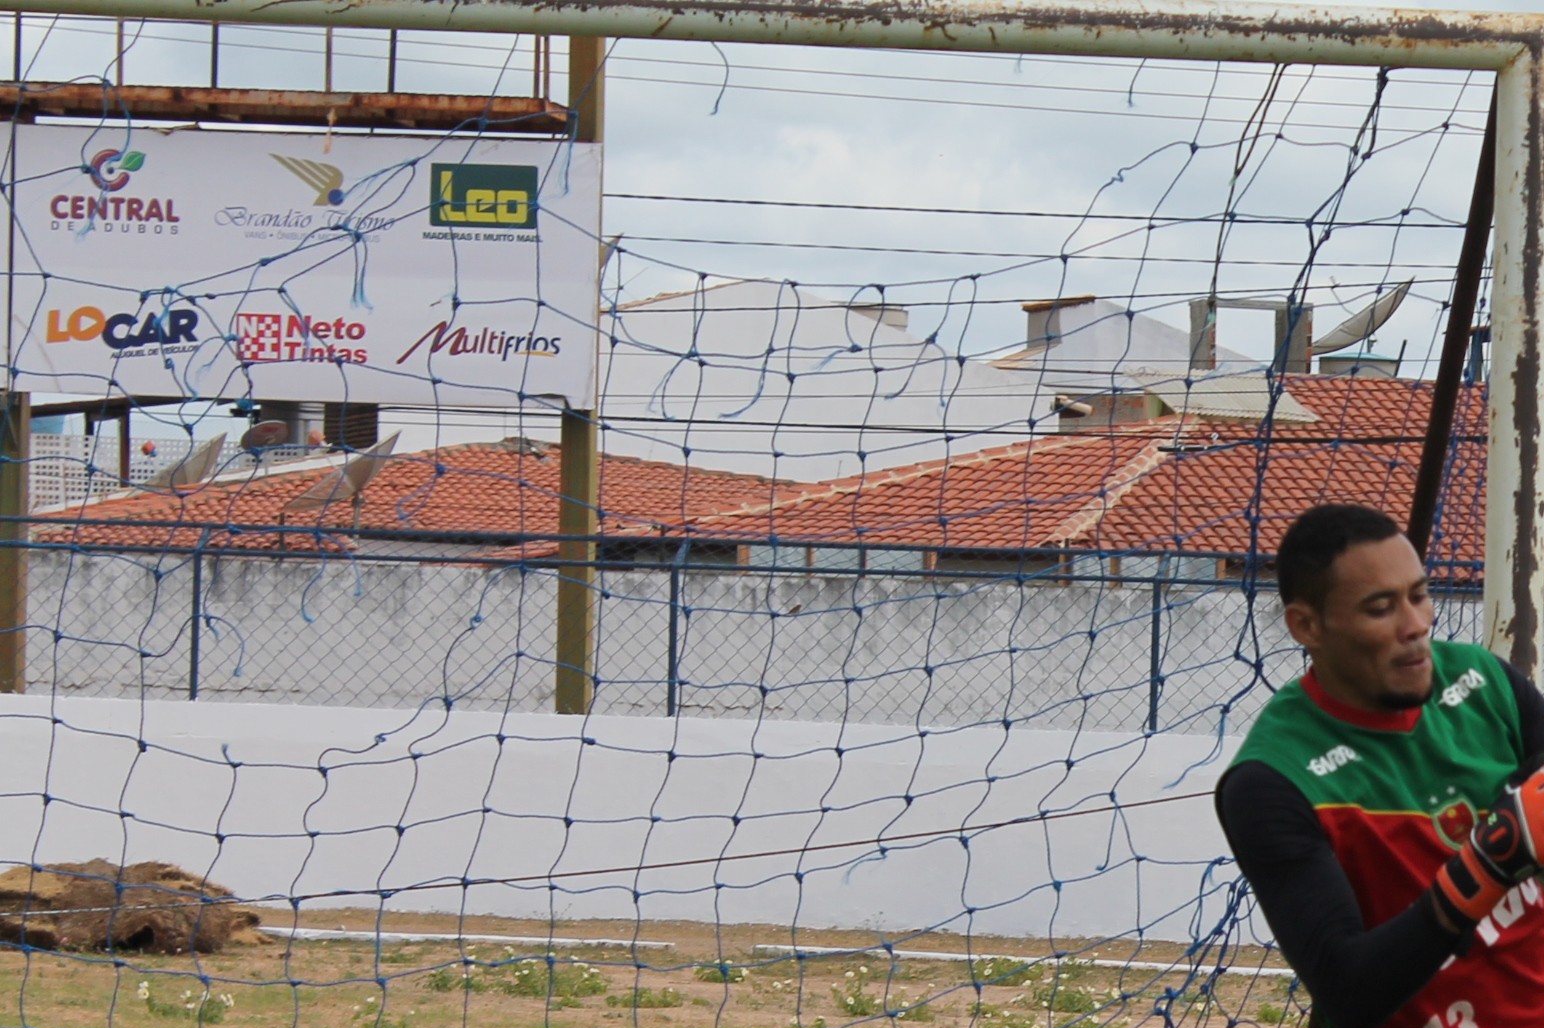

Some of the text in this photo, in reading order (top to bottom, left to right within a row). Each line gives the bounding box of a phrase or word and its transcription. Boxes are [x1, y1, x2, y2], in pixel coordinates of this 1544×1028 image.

[50, 194, 180, 223] CENTRAL
[440, 171, 528, 223] Leo
[50, 220, 179, 235] DE ADUBOS
[214, 206, 313, 228] Brandão
[422, 231, 473, 241] MADEIRAS
[474, 232, 482, 241] E
[483, 233, 515, 242] MUITO
[46, 305, 199, 350] LOCAR
[285, 315, 367, 340] Neto
[147, 348, 160, 357] DE
[284, 341, 368, 364] Tintas
[396, 321, 562, 364] Multifrios
